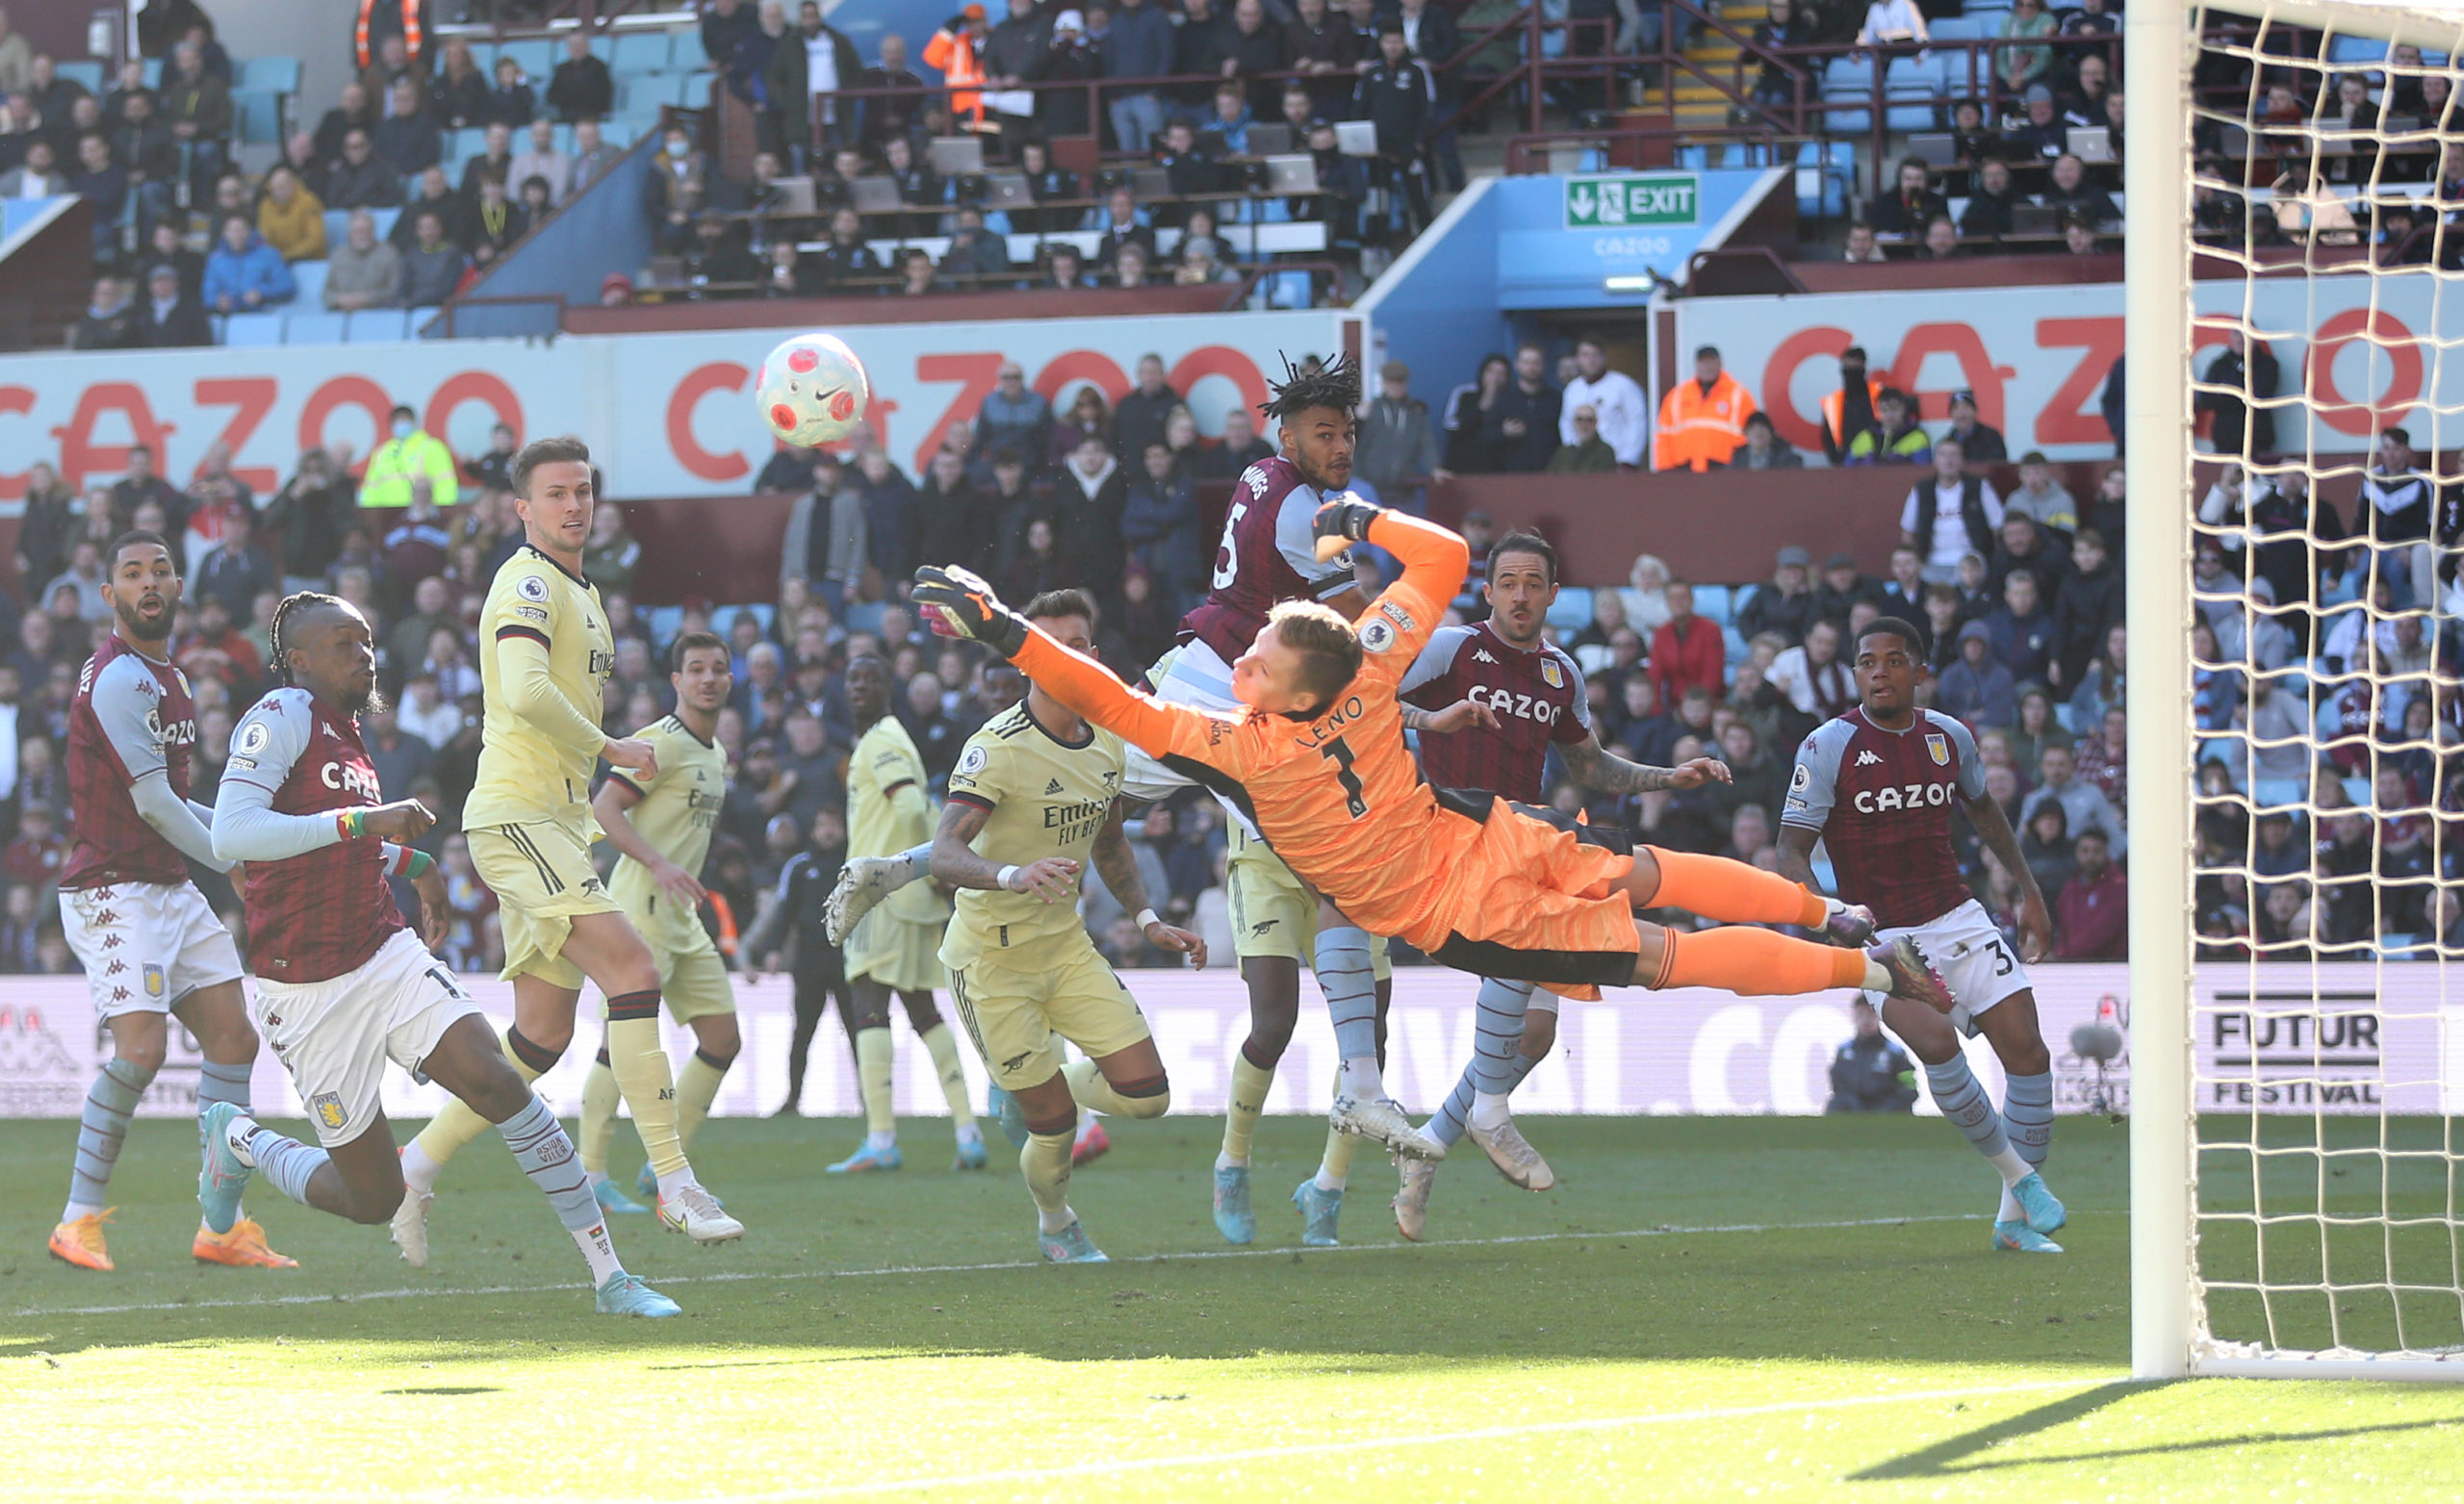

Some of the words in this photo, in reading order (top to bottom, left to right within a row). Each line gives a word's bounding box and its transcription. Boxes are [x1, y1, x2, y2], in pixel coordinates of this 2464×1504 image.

[1630, 186, 1694, 214] EXIT
[1594, 237, 1671, 256] CAZOO
[665, 344, 1270, 481] CZOO
[1240, 466, 1269, 500] MINGS
[1213, 501, 1247, 590] 5
[78, 652, 97, 697] UIZ
[1296, 696, 1363, 748] LENO
[321, 761, 382, 803] CAZ
[1322, 736, 1370, 821] 1
[1059, 824, 1079, 847] FLY
[1986, 940, 2013, 977] 3
[2215, 1012, 2379, 1049] FUTUR
[658, 1088, 675, 1100] AF
[2215, 1078, 2382, 1105] FESTIVAL
[540, 1146, 568, 1162] VILLA
